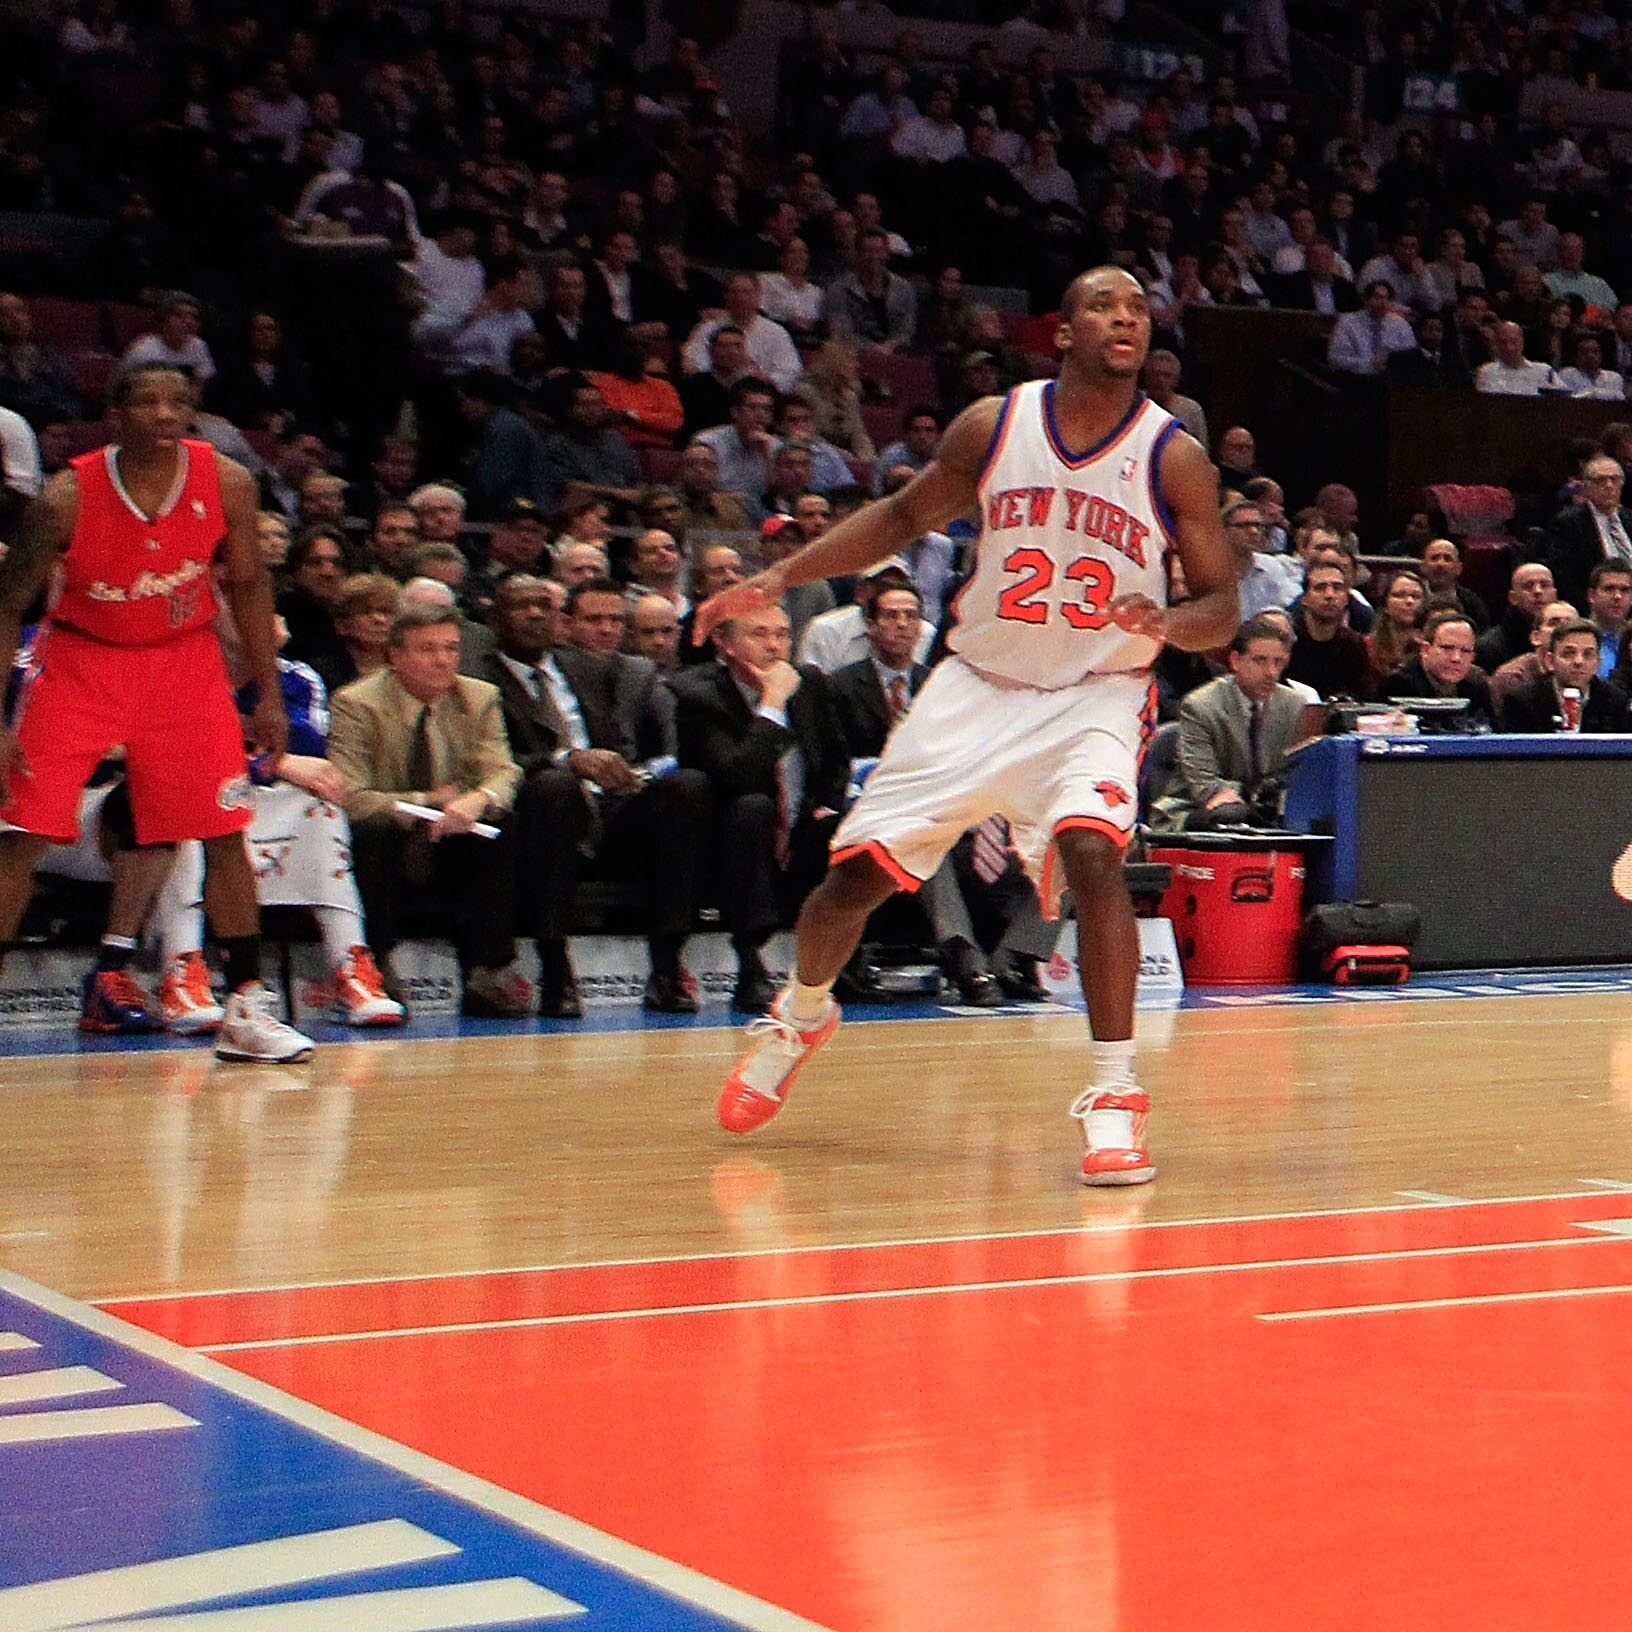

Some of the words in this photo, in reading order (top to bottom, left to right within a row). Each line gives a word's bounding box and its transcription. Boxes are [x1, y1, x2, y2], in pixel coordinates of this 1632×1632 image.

[989, 486, 1056, 531] NEW
[1064, 487, 1150, 569] YORK
[996, 546, 1116, 631] 23
